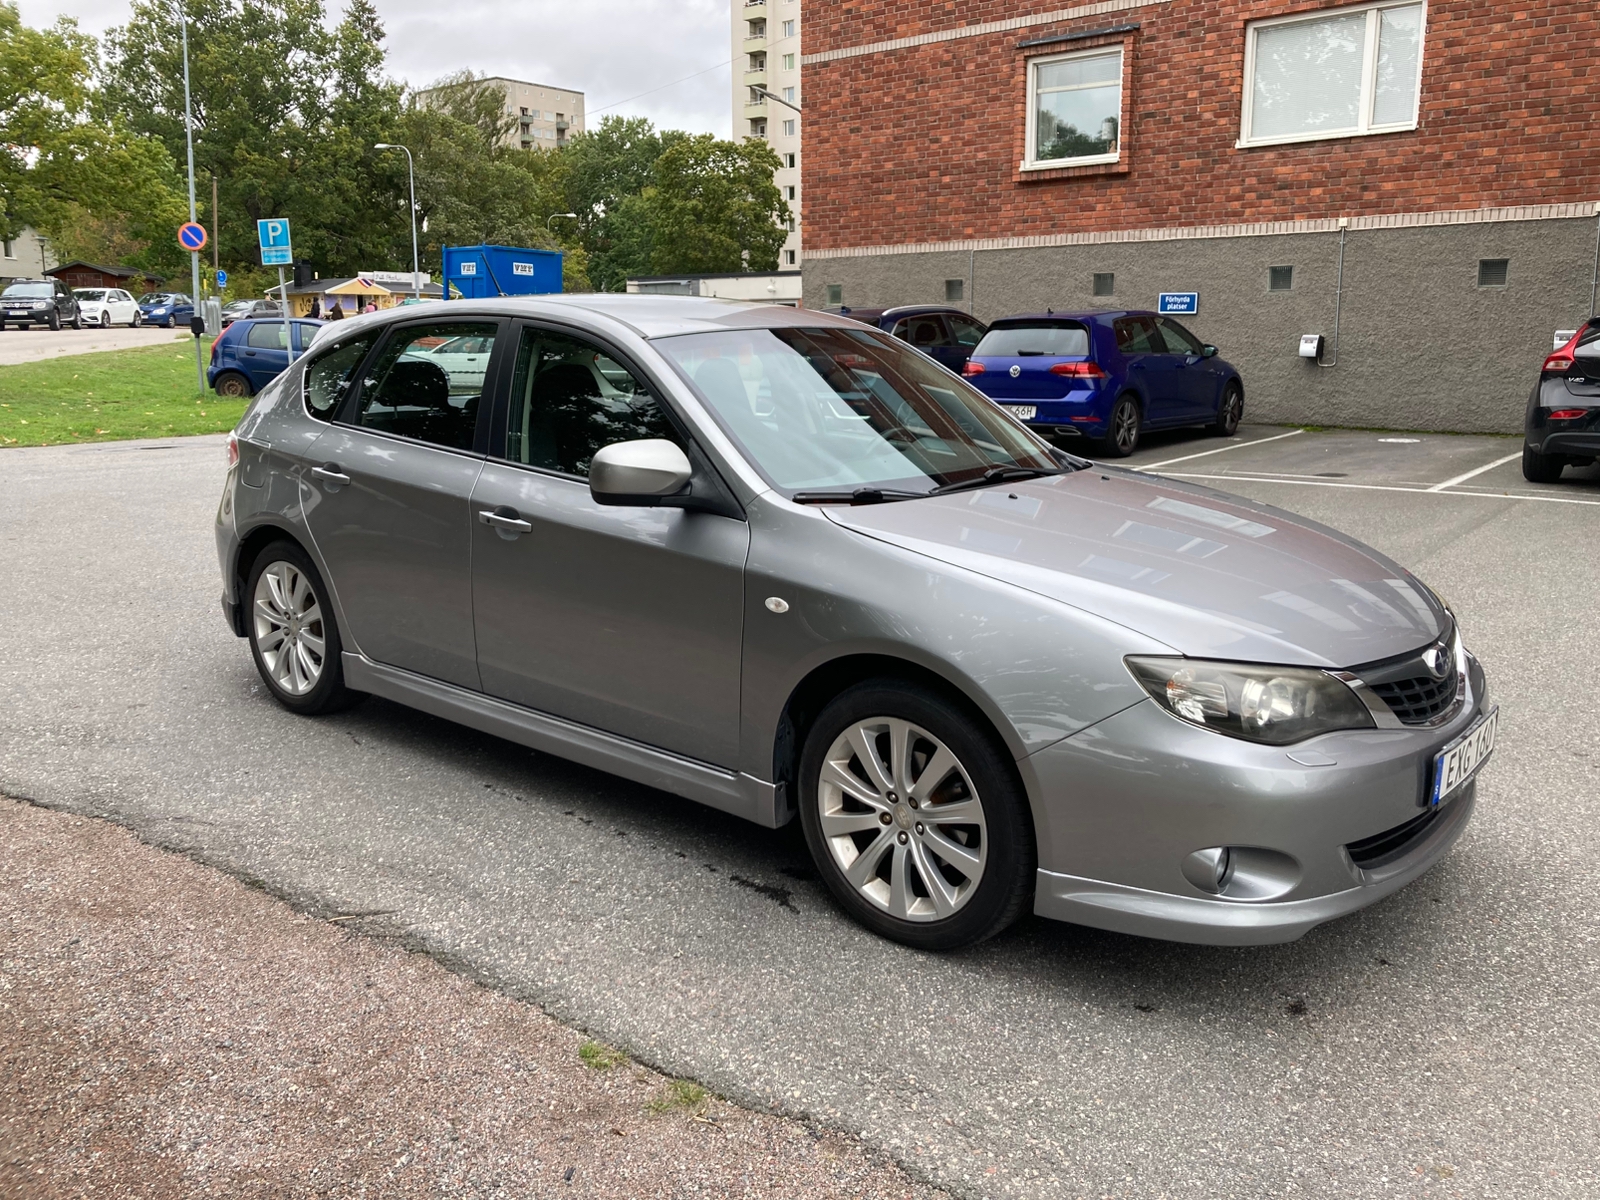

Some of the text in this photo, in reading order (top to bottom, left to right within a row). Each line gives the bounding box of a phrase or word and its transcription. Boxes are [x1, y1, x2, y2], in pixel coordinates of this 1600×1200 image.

[267, 221, 282, 245] P
[1446, 717, 1494, 789] EXG 160
